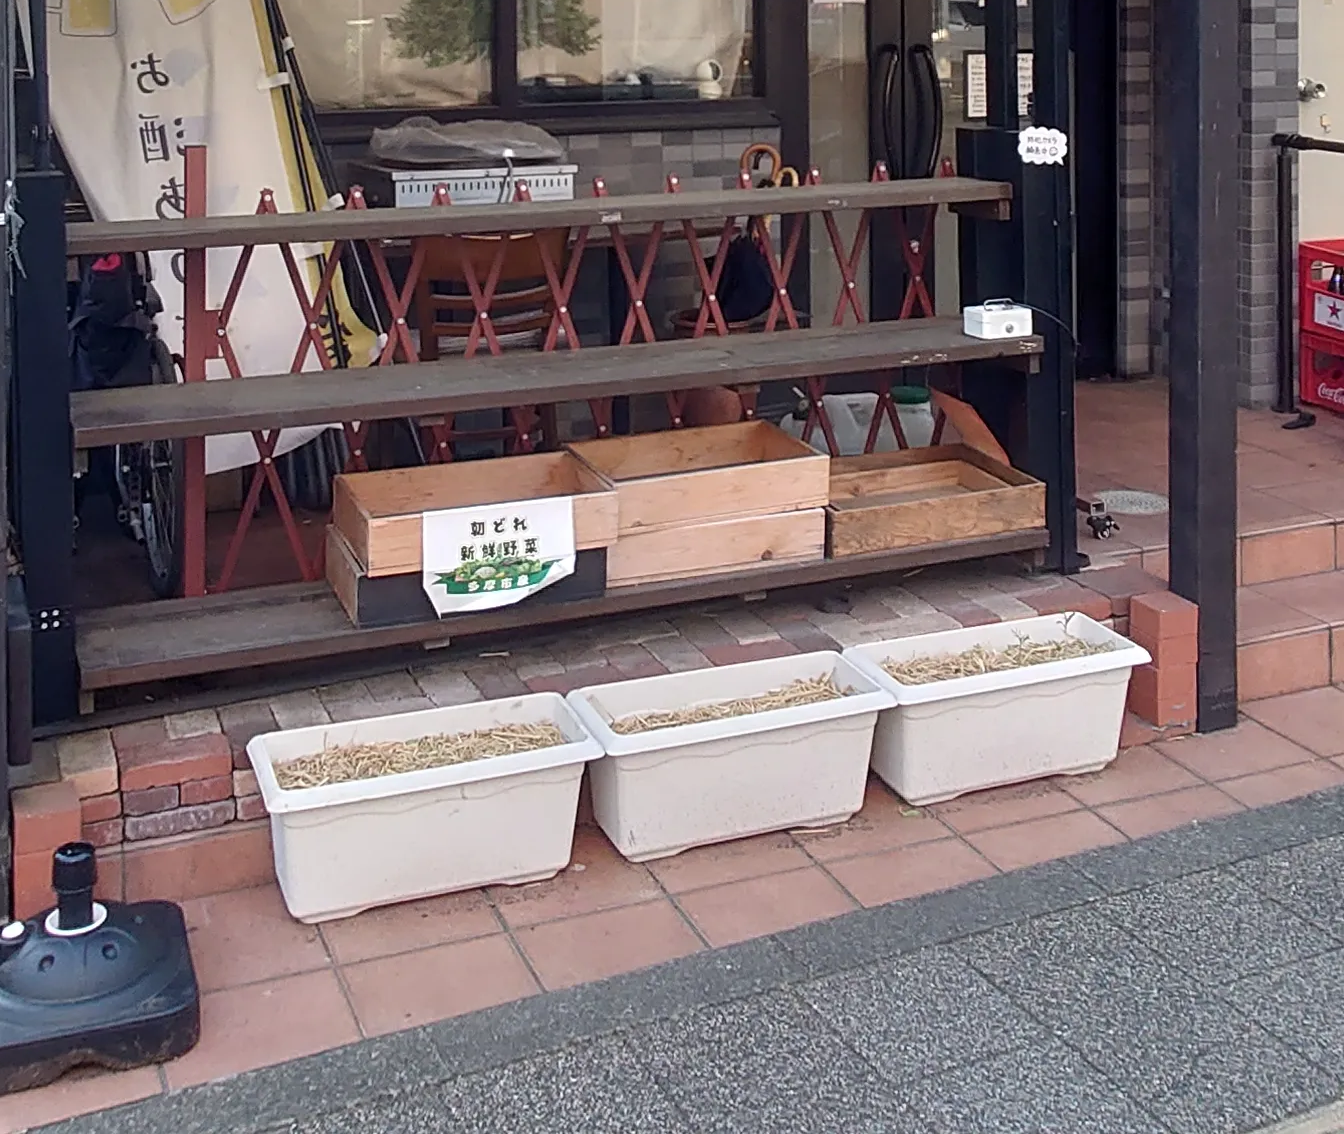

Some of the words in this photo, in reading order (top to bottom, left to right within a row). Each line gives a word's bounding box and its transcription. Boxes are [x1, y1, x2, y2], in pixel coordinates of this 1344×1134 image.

[470, 517, 528, 537] 朝どれ
[460, 537, 538, 561] 新鮮野菜
